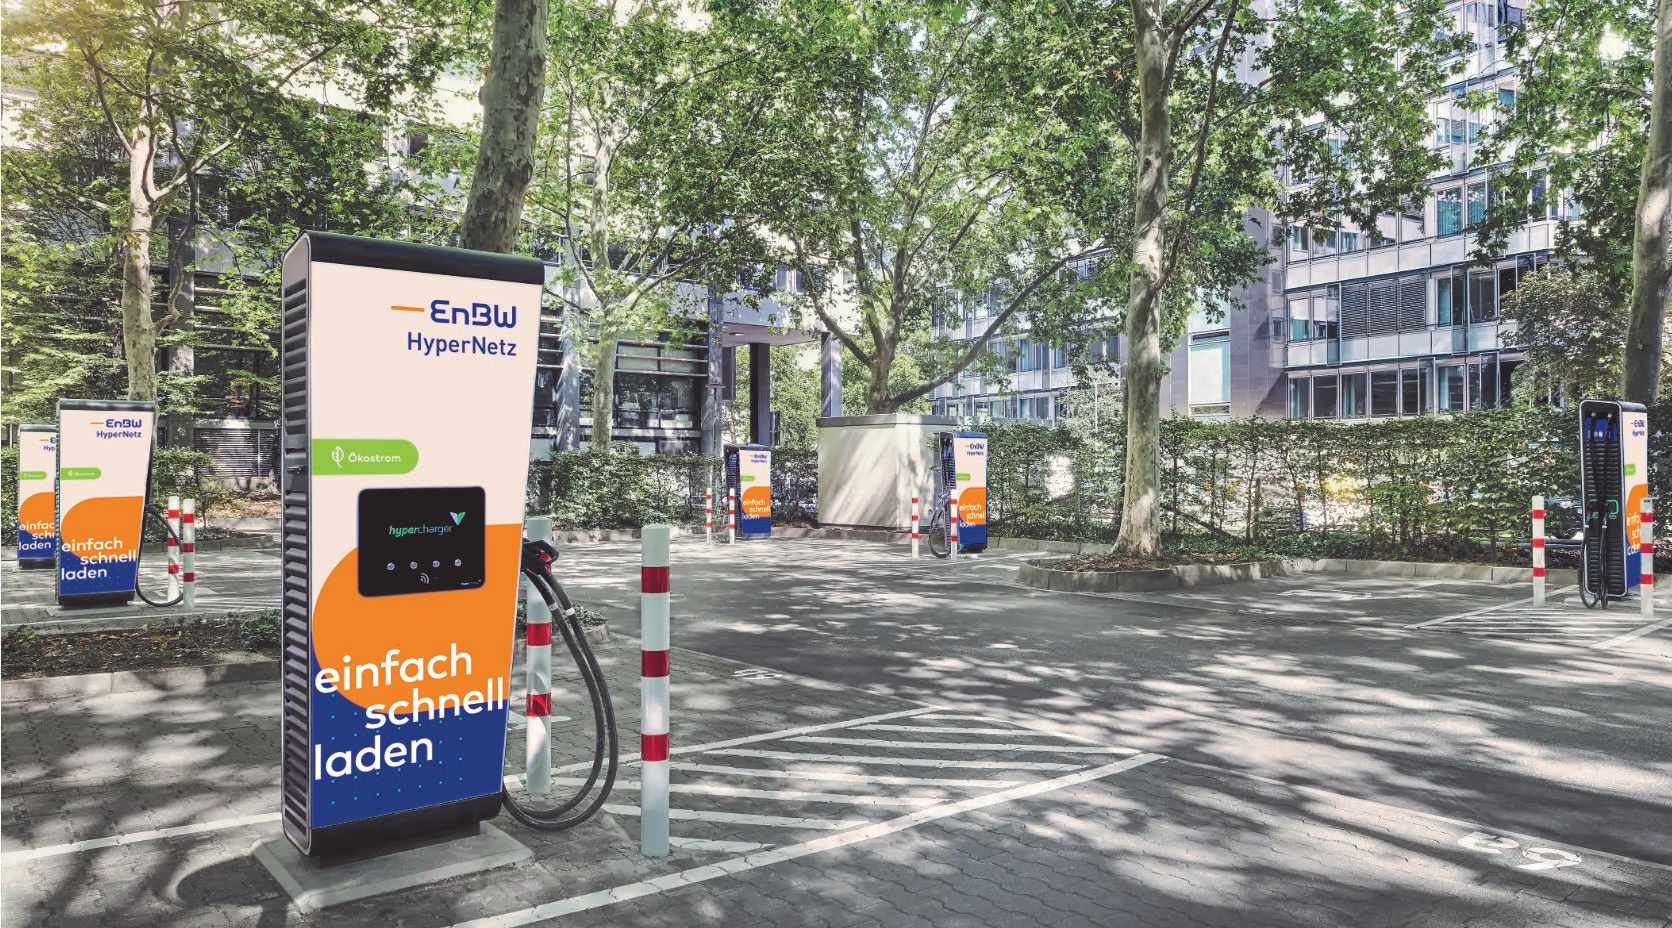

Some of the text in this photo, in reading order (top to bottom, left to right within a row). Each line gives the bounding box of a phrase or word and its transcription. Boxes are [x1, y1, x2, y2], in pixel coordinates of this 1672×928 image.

[430, 299, 517, 329] EnBW
[407, 332, 517, 356] HyperNetz
[105, 418, 142, 428] EnBW
[96, 431, 142, 439] HyperNetz
[348, 452, 401, 464] Ökostrom
[388, 524, 454, 538] hypercharger
[18, 541, 51, 550] laden
[62, 537, 123, 553] einfach
[80, 550, 136, 565] schnell
[61, 566, 107, 581] laden
[315, 642, 473, 694] einfach
[365, 677, 504, 730] schnell
[314, 735, 433, 781] laden
